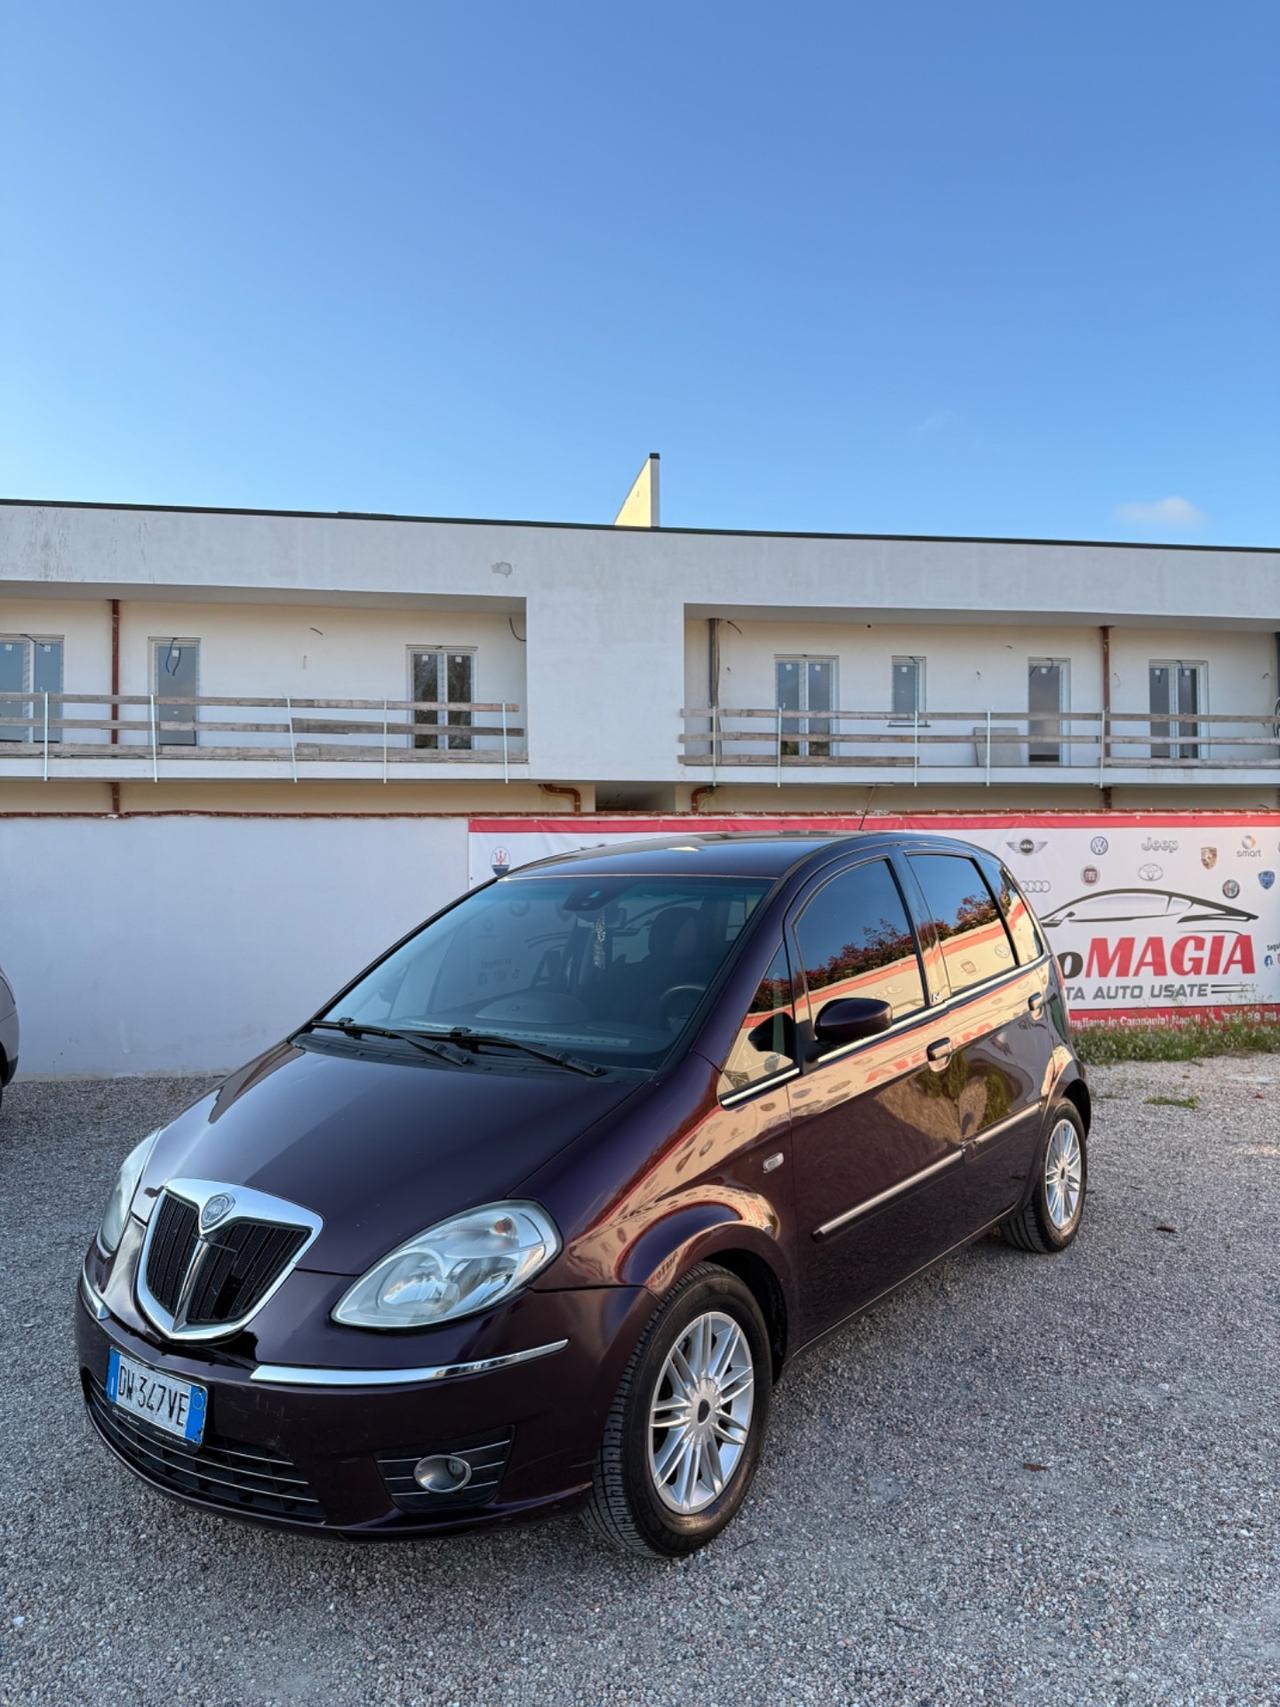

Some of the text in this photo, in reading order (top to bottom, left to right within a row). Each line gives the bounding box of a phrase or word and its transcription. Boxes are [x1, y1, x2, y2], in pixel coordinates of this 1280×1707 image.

[1141, 836, 1179, 853] Jeep
[1236, 849, 1261, 857] smart
[1093, 985, 1143, 1000] AUTO
[1150, 983, 1208, 999] USATE
